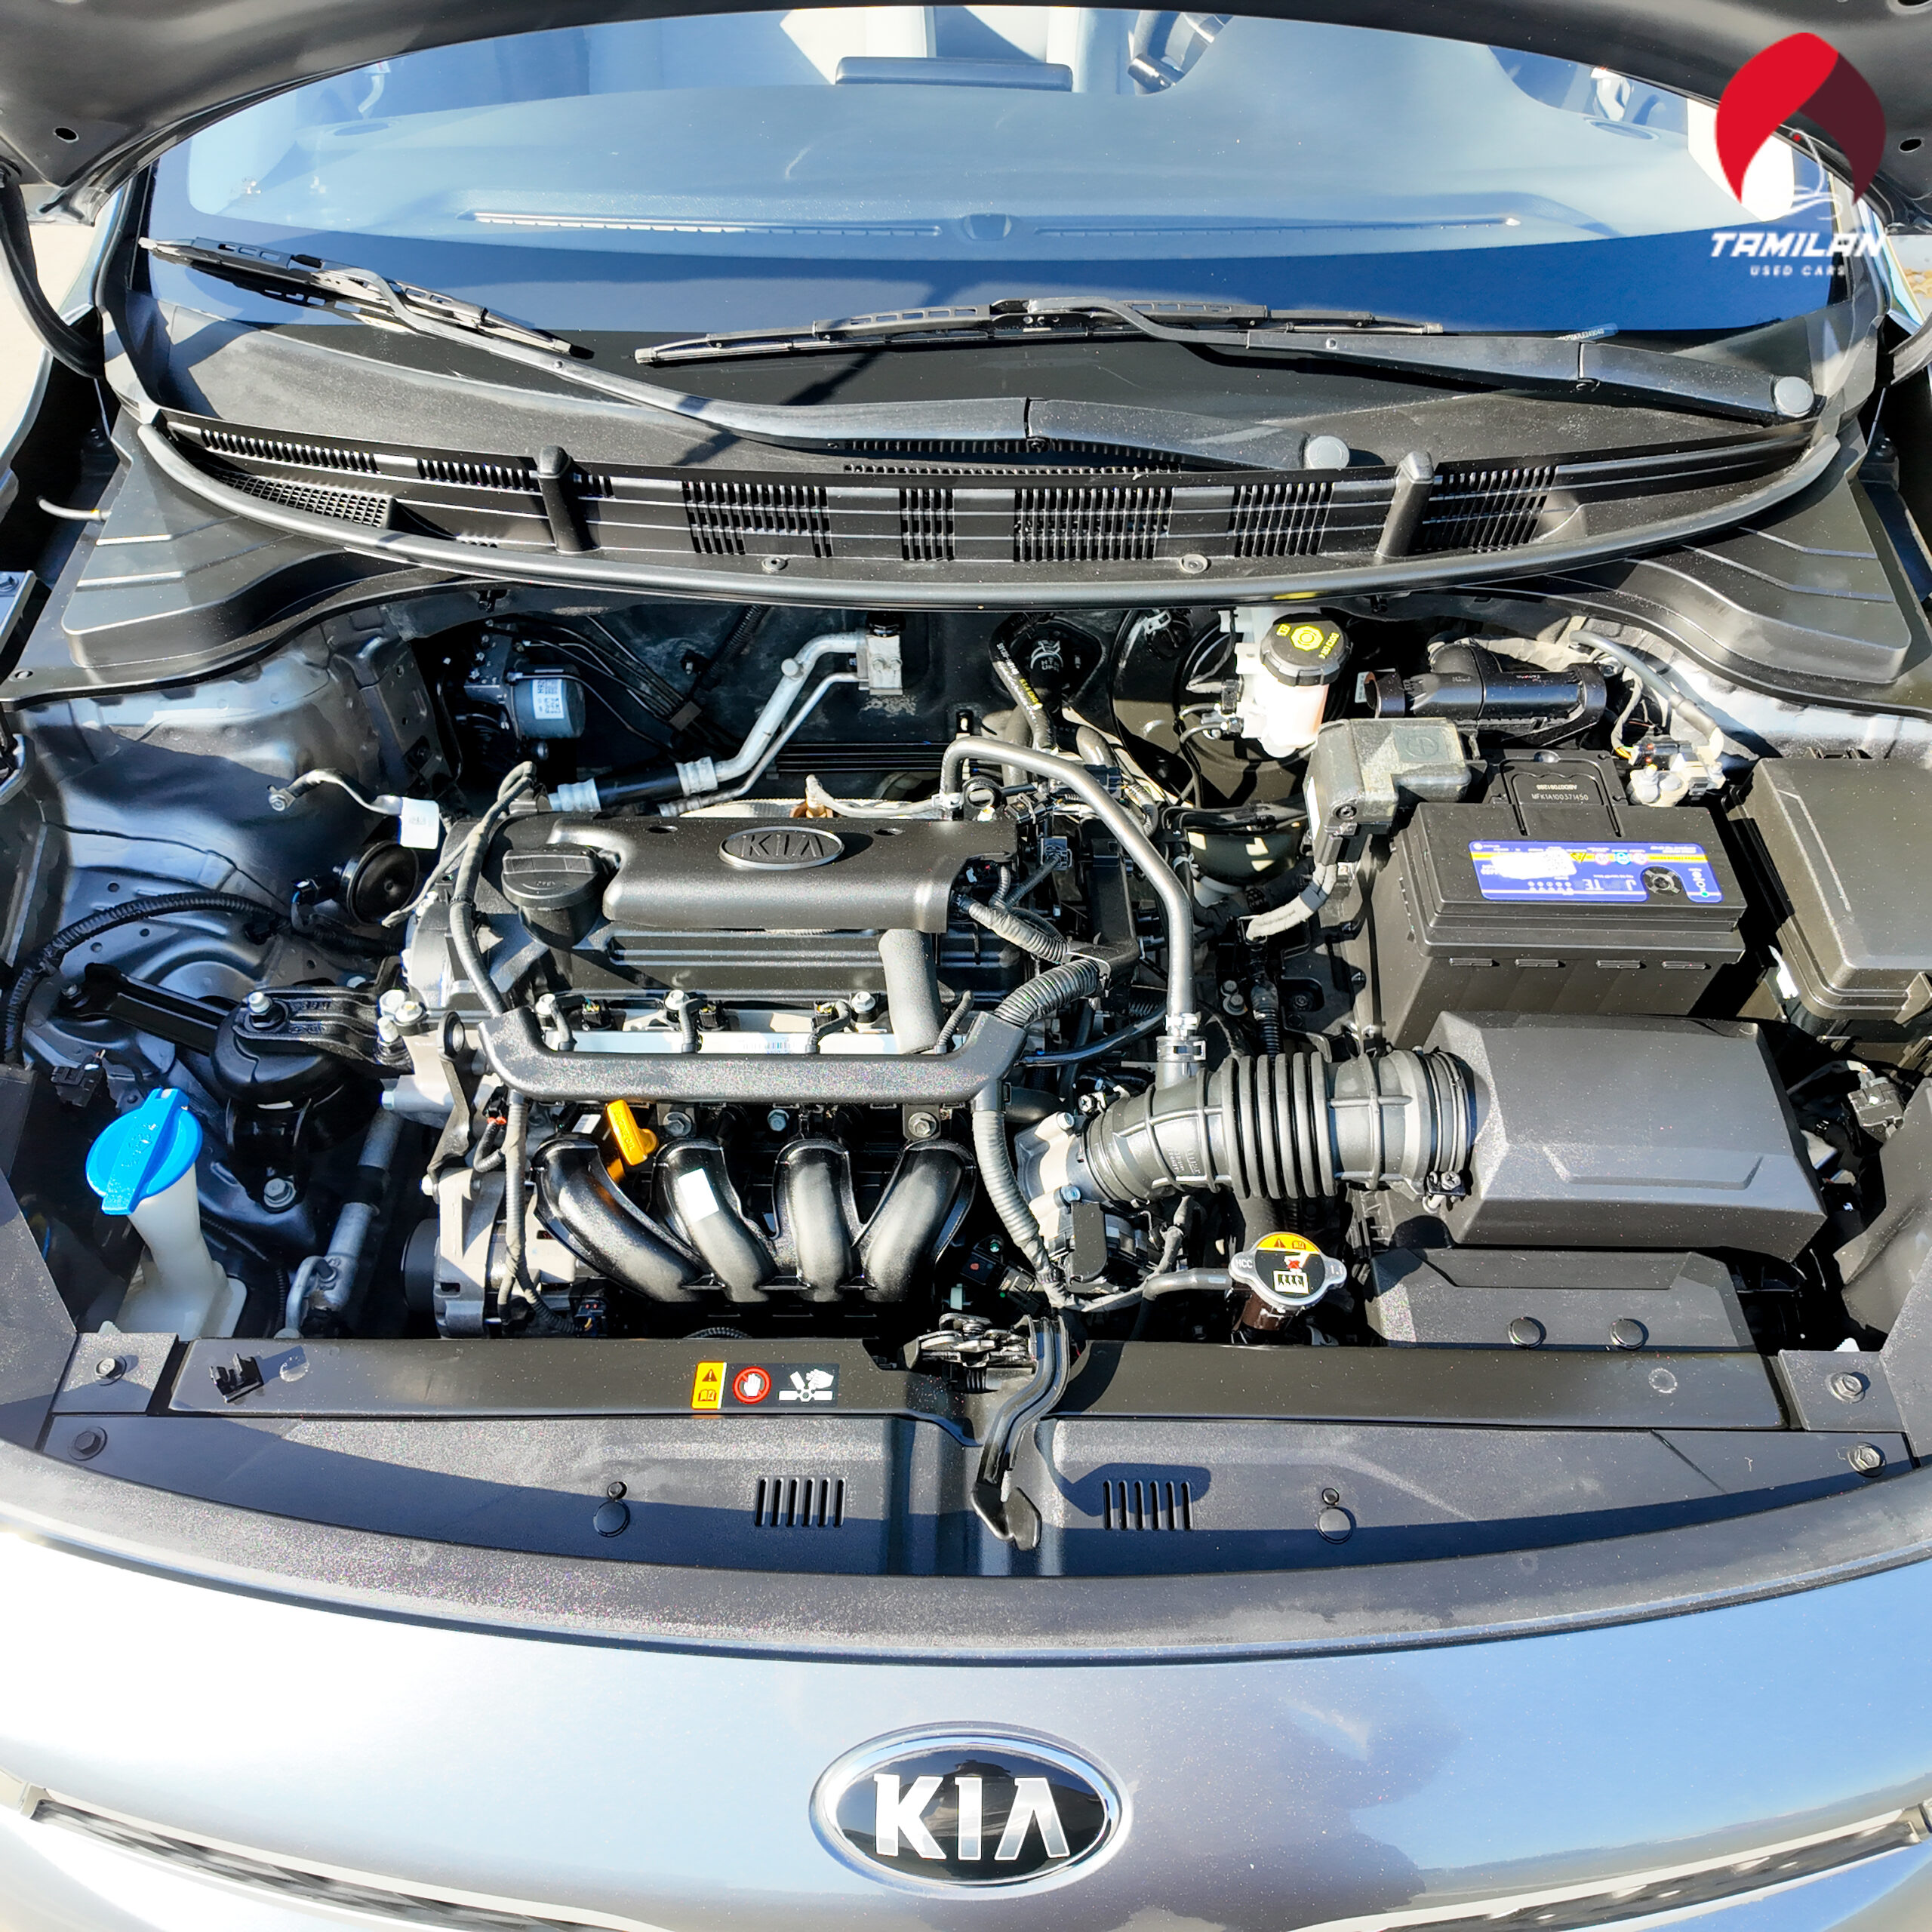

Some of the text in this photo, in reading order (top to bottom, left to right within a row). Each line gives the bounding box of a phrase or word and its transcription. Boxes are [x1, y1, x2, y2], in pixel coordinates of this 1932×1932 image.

[741, 834, 824, 857] KIA
[624, 1137, 635, 1152] OIL
[1235, 1259, 1343, 1275] HCC 1.1
[873, 1773, 1071, 1862] KIA
